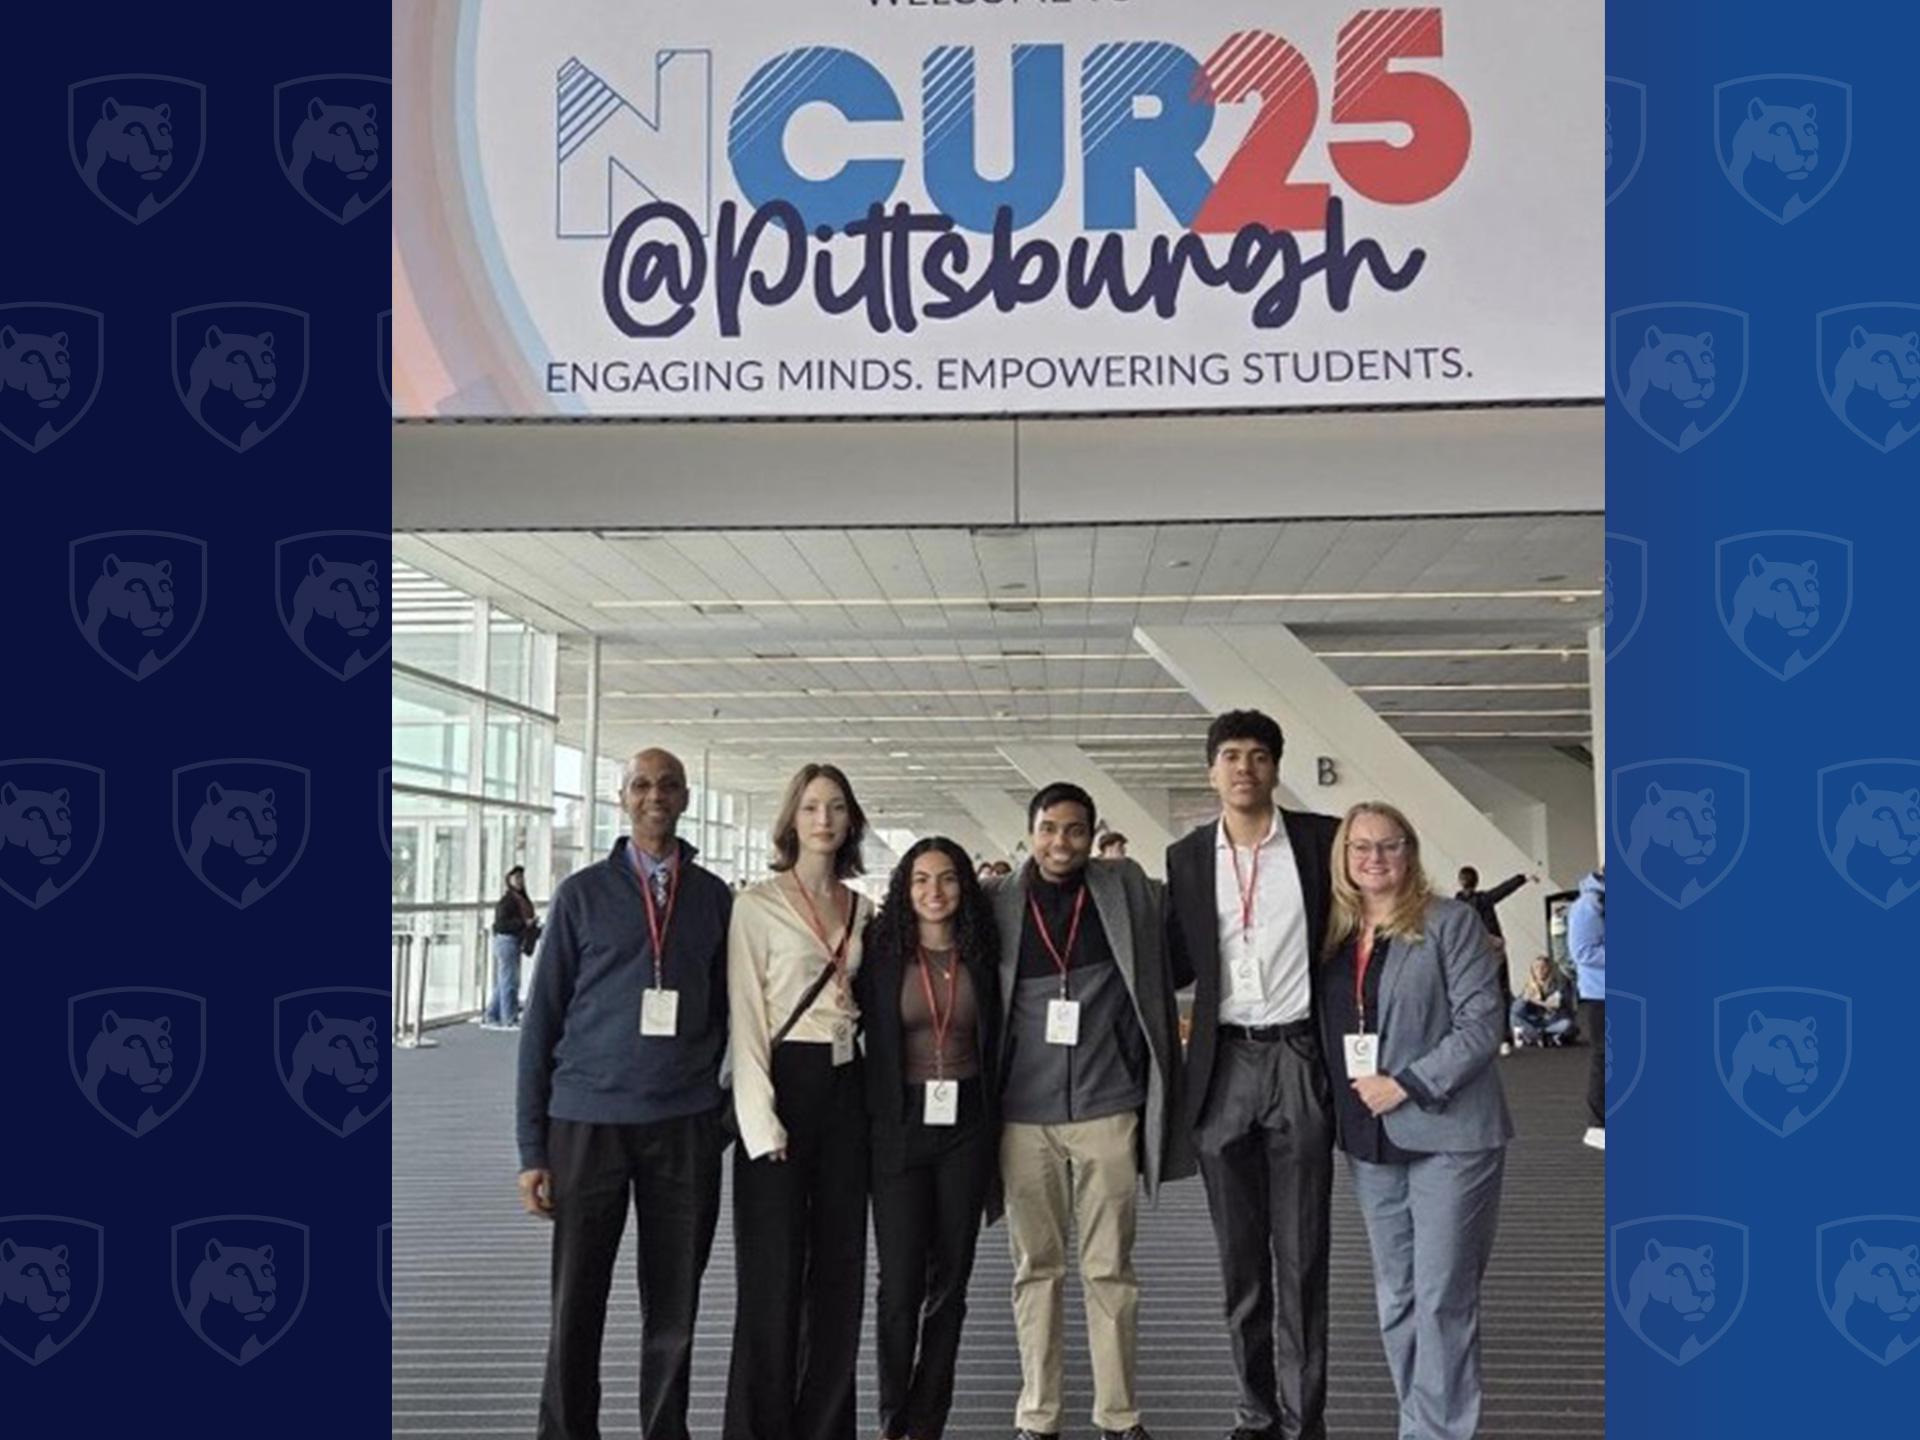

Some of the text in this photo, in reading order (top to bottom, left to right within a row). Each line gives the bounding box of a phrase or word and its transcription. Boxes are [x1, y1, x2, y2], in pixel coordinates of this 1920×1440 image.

[603, 196, 1426, 337] @Pittsburgh
[546, 347, 1473, 393] ENGAGING MINDS. EMPOWERING STUDENTS.
[1317, 757, 1339, 786] B
